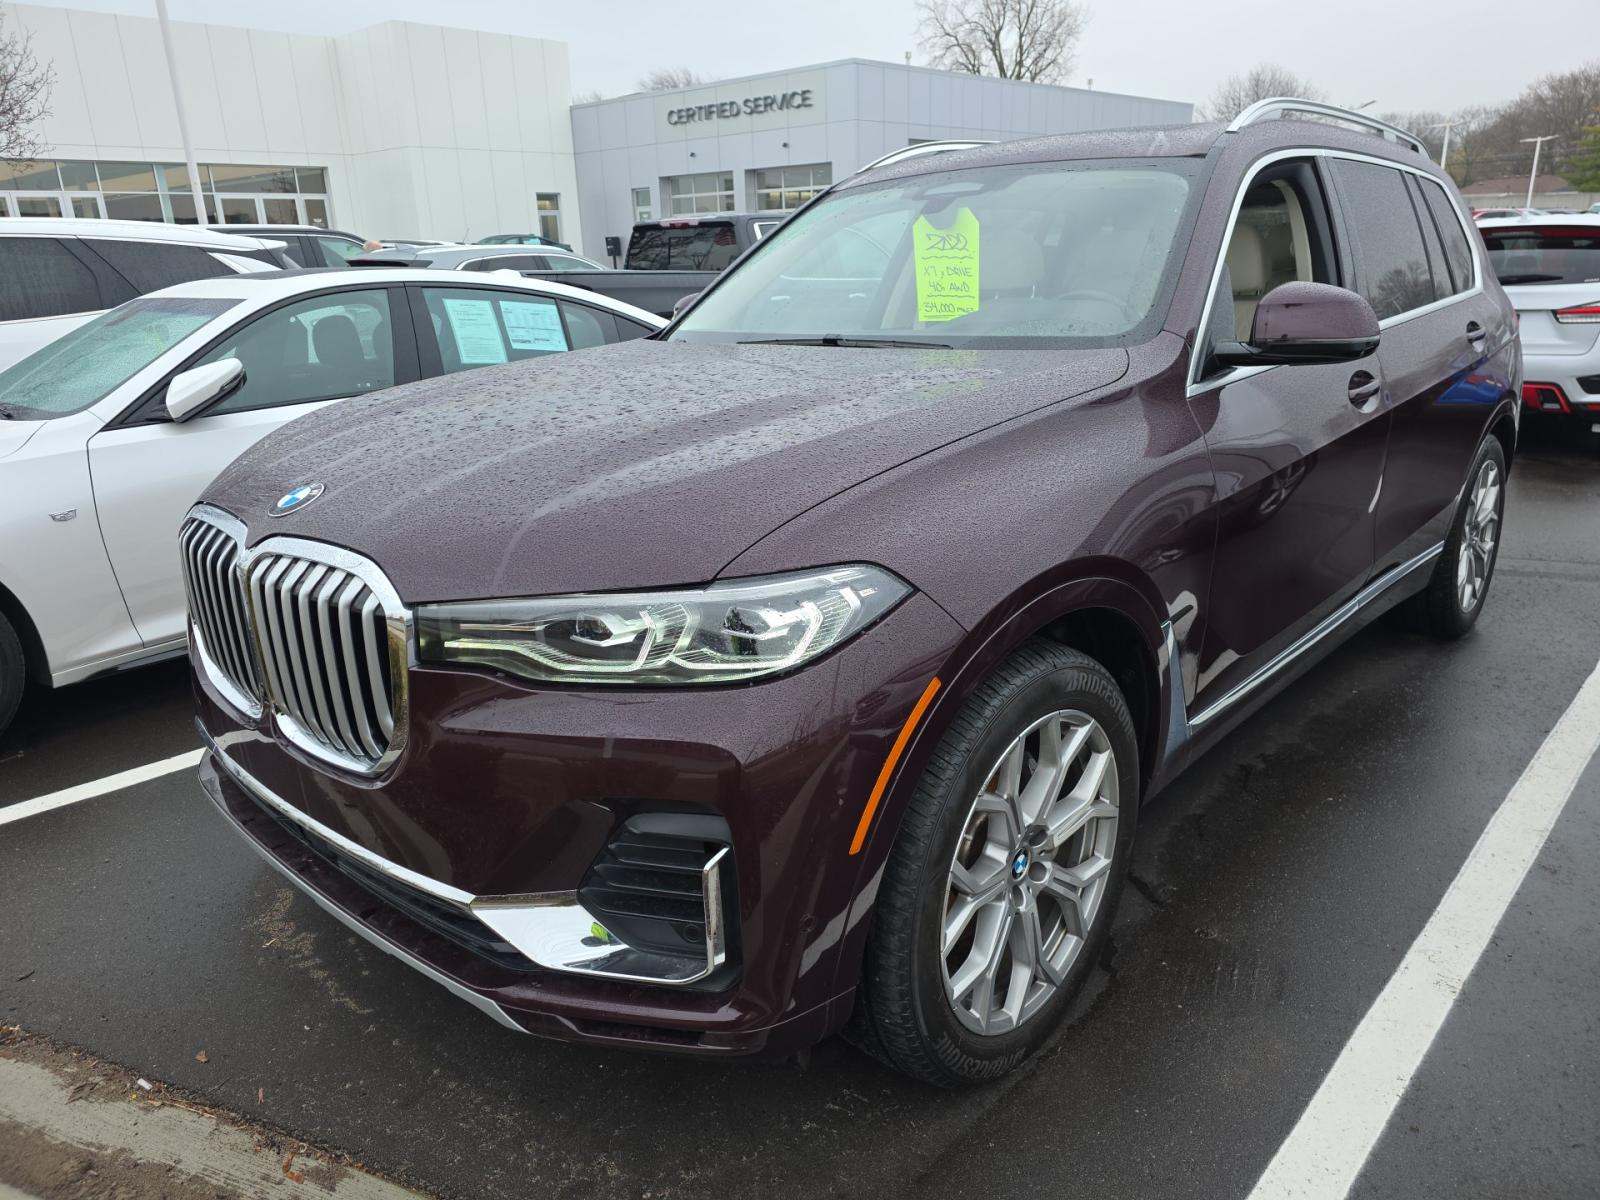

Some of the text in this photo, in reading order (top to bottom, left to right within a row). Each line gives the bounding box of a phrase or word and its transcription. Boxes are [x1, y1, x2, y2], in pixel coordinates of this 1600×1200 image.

[667, 89, 814, 126] CERTIFIED SERVICE
[1065, 669, 1136, 737] BRIDGESTONE
